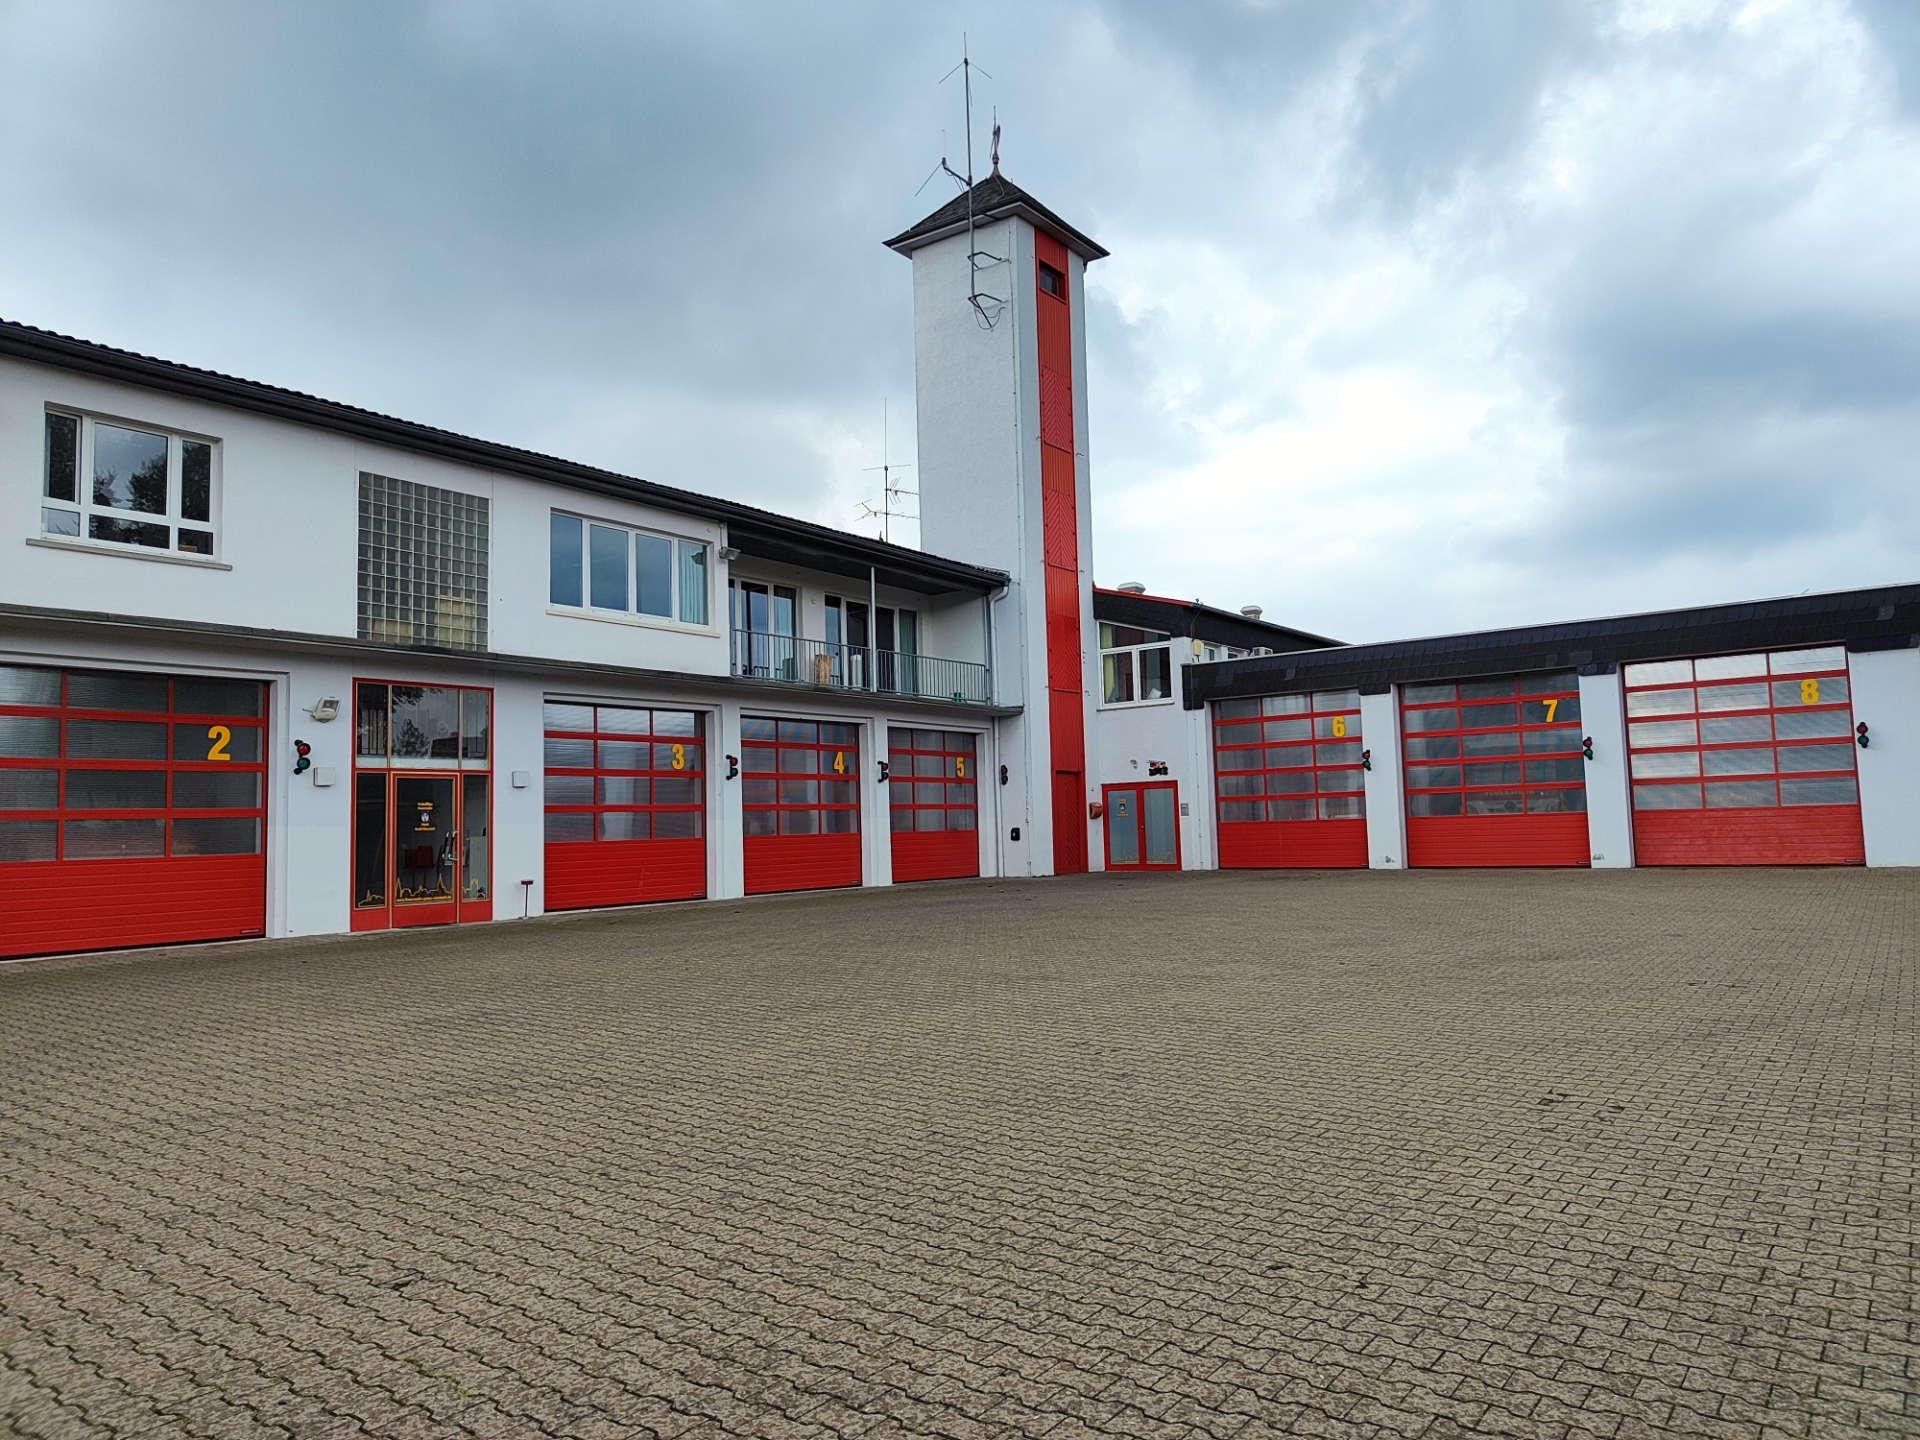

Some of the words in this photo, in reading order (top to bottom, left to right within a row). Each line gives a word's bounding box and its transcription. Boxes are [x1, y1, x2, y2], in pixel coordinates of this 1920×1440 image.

[1801, 679, 1819, 705] 8
[1542, 699, 1558, 723] 7
[1332, 716, 1346, 737] 6
[207, 725, 231, 761] 2
[671, 743, 685, 770] 3
[833, 751, 844, 774] 4
[956, 757, 965, 778] 5
